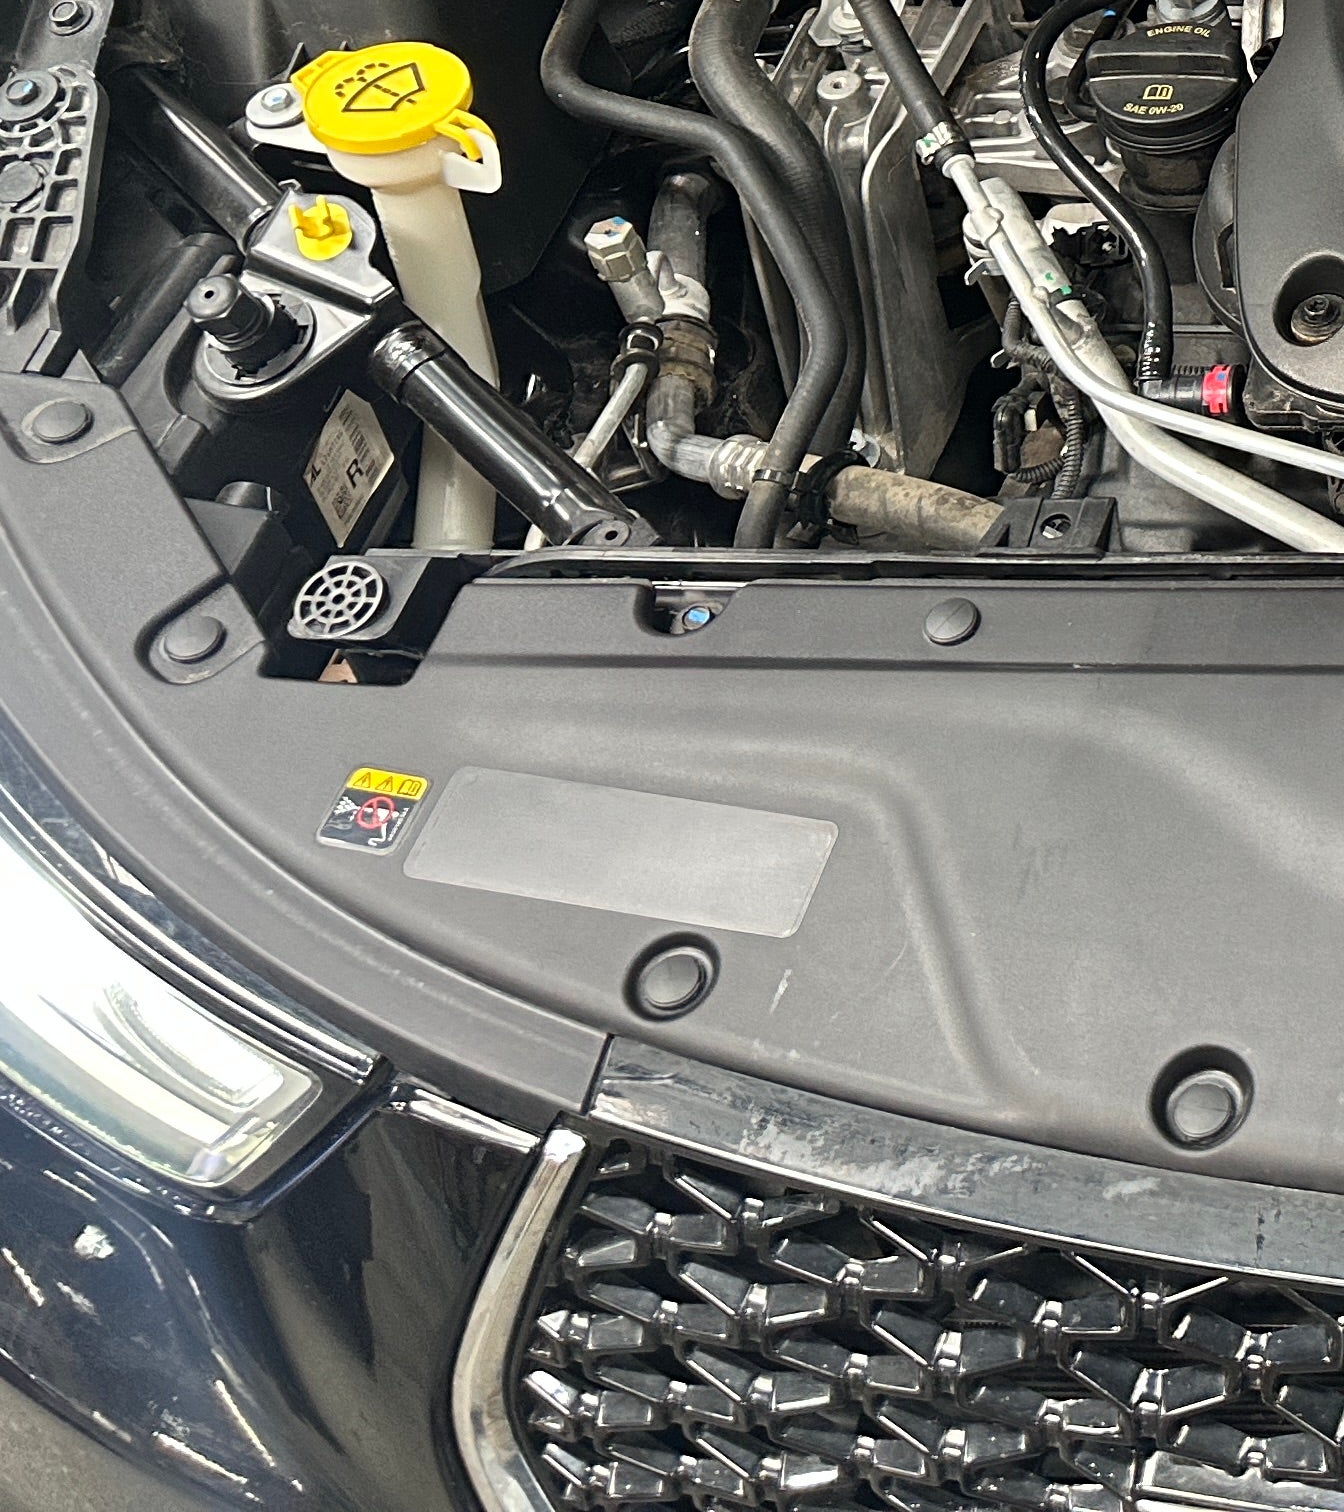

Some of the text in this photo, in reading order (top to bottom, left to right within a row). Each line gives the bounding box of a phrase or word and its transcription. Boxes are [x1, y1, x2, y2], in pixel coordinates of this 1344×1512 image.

[1146, 25, 1211, 38] ENGINE OIL
[1123, 103, 1184, 115] SAE 0W-20
[346, 458, 364, 489] R
